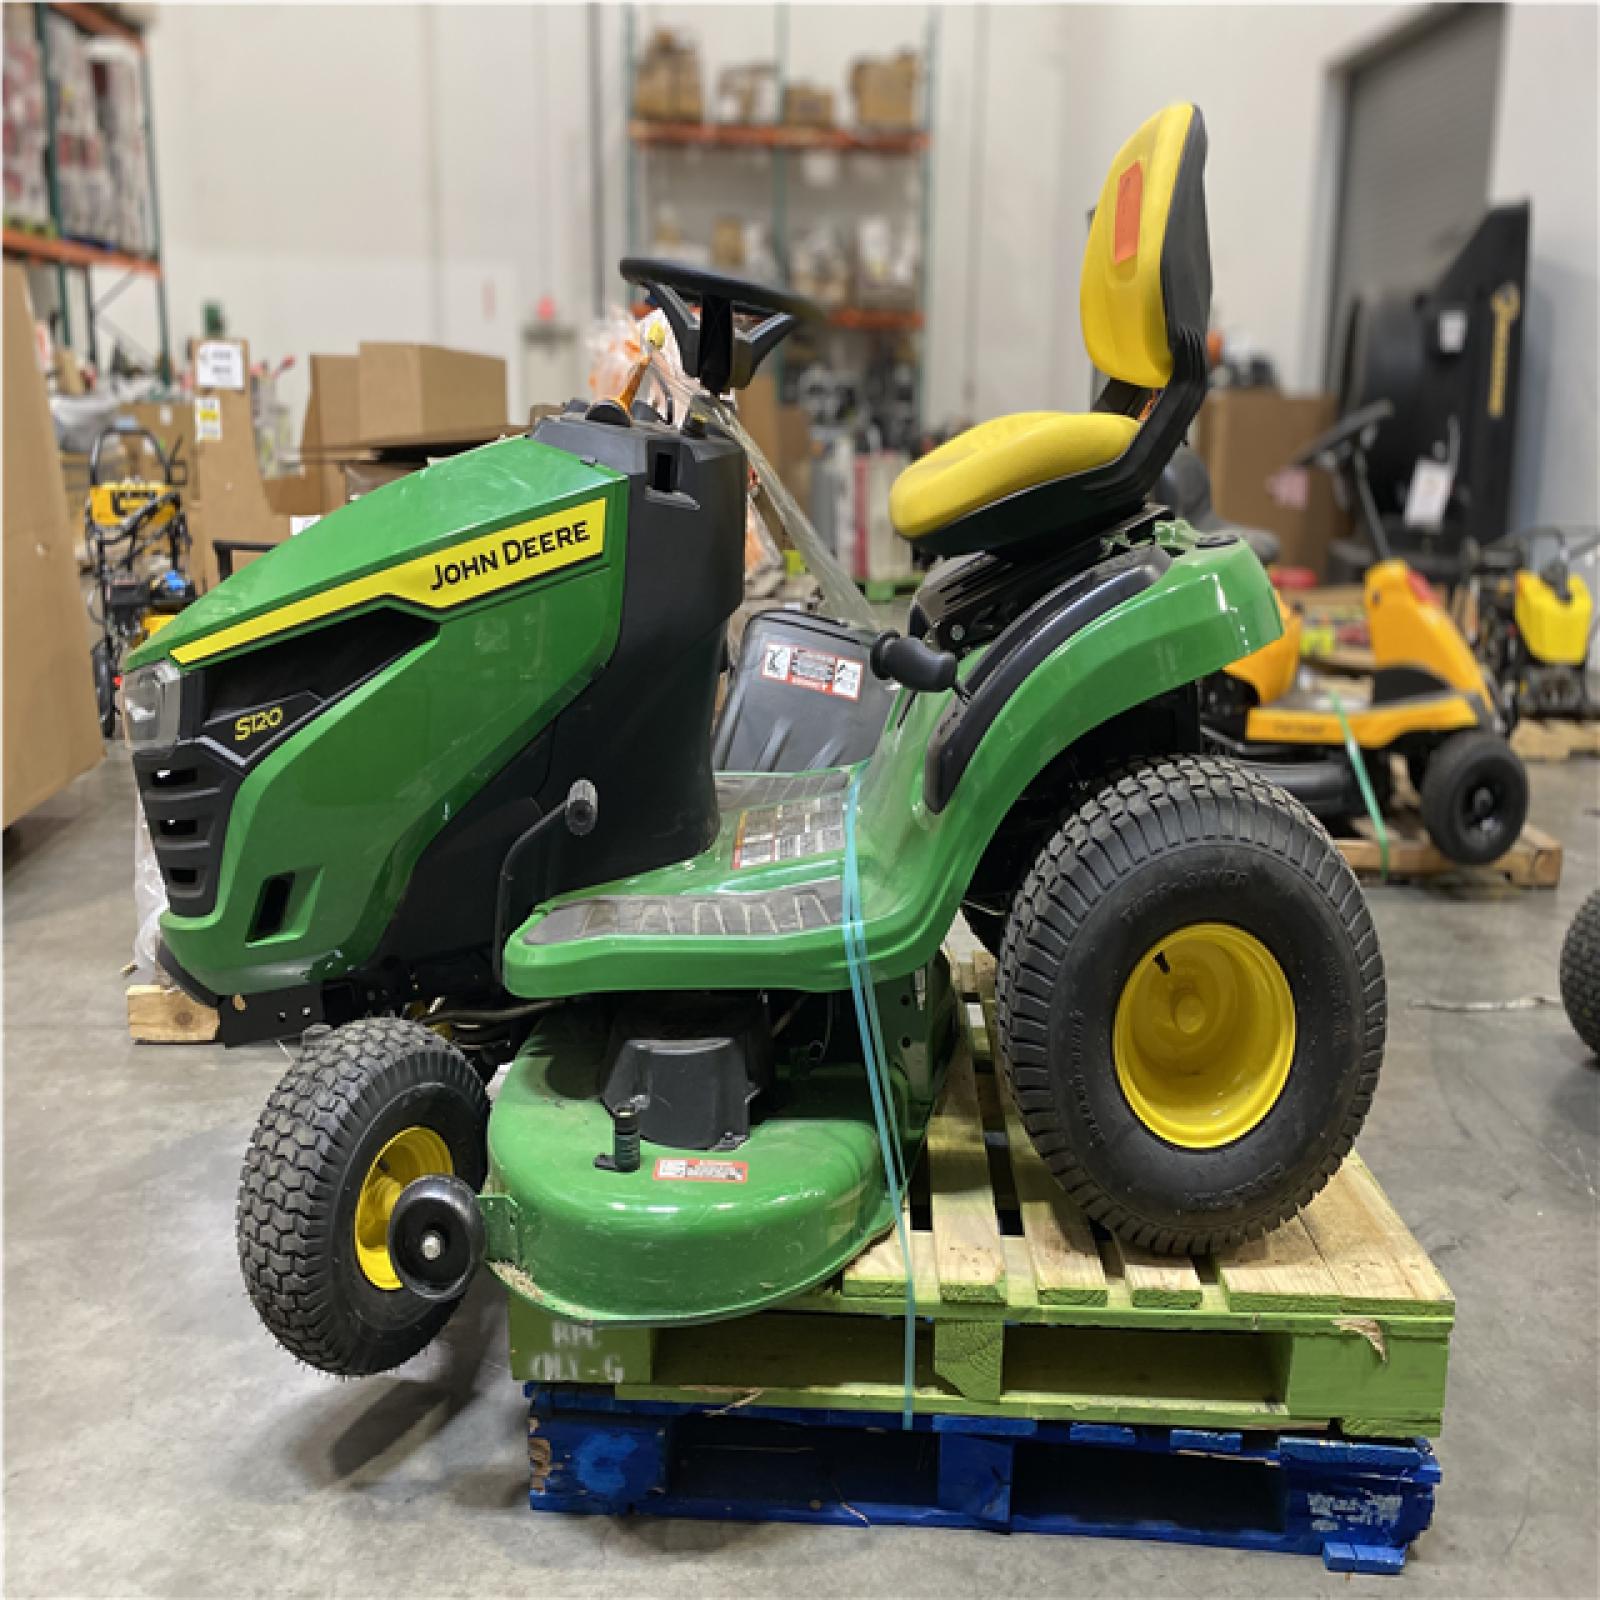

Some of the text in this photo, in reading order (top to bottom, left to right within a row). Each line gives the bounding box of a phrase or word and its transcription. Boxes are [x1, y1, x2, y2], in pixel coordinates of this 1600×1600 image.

[430, 520, 591, 591] JOHN DEERE
[234, 706, 284, 741] S120
